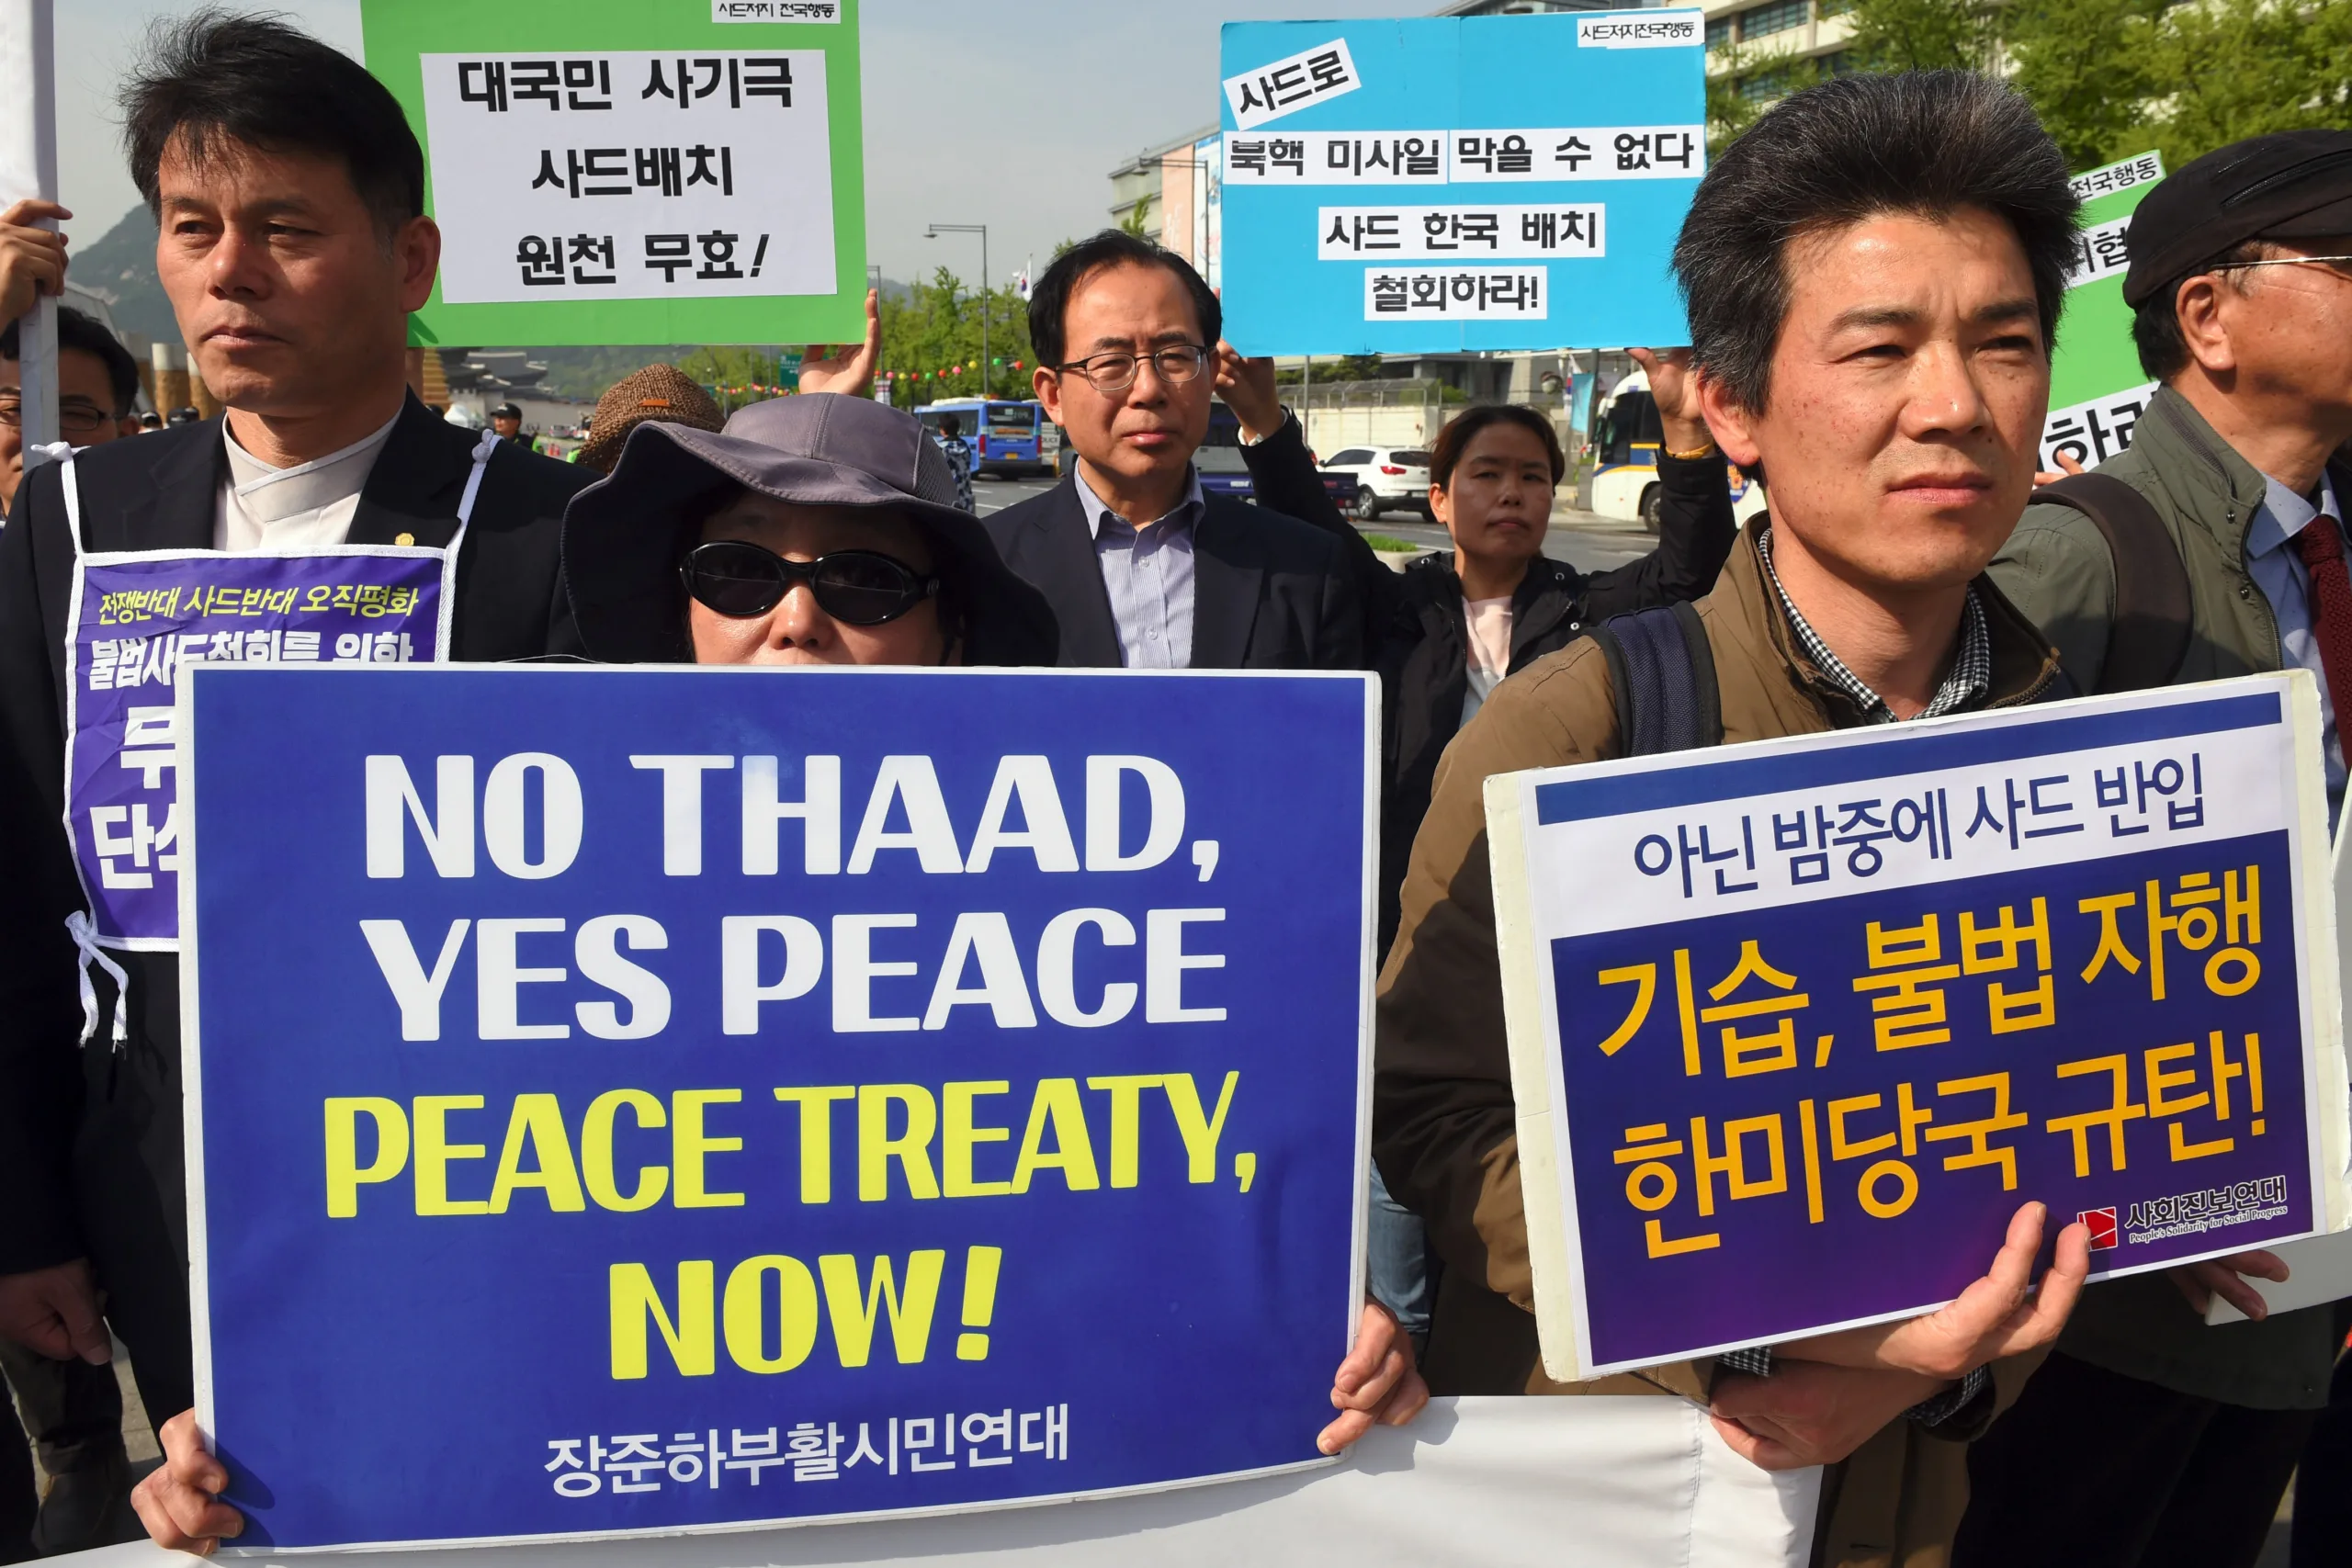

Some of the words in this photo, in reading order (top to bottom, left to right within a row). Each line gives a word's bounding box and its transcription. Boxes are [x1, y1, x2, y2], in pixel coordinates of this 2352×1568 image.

[718, 3, 774, 17] 사드저지
[780, 3, 835, 18] 전국행동
[458, 60, 612, 112] 대국민
[641, 58, 792, 109] 사기극
[1239, 50, 1350, 115] 사드로
[533, 145, 732, 198] 사드배치
[1229, 139, 1304, 176] 북핵
[1327, 138, 1440, 176] 미사일
[1457, 134, 1532, 174] 막을
[1555, 136, 1591, 172] 수
[1613, 132, 1694, 171] 없다
[516, 234, 616, 286] 원천
[645, 230, 769, 283] 무효!
[1326, 215, 1401, 252] 사드
[1423, 212, 1498, 250] 한국
[1521, 210, 1596, 249] 배치
[1372, 273, 1538, 313] 철회하라!
[99, 586, 181, 626] 전쟁반대
[184, 585, 300, 619] 사드반대
[300, 584, 419, 618] 오직평화
[366, 751, 583, 880] NO
[629, 755, 1219, 882] THAAD,
[1634, 815, 1758, 898] 아닌
[1772, 787, 1952, 886] 밤중에
[1965, 774, 2085, 850] 사드
[2094, 752, 2204, 838] 반입
[359, 914, 672, 1042] YES
[722, 908, 1227, 1035] PEACE
[1598, 940, 1835, 1077] 기습,
[1852, 897, 2055, 1052] 불법
[2078, 864, 2261, 1001] 자행
[324, 1089, 745, 1218] PEACE
[774, 1071, 1256, 1204] TREATY,
[1613, 1072, 2028, 1259] 한미당국
[2046, 1030, 2266, 1178] 규탄!
[2124, 1175, 2287, 1229] 사회진보연대
[2166, 1218, 2209, 1236] Solidarity
[2209, 1217, 2223, 1229] for
[2223, 1210, 2250, 1224] Social
[2251, 1205, 2288, 1222] Progress
[609, 1246, 1002, 1380] NOW!
[544, 1404, 1069, 1497] 장준하부활시민연대
